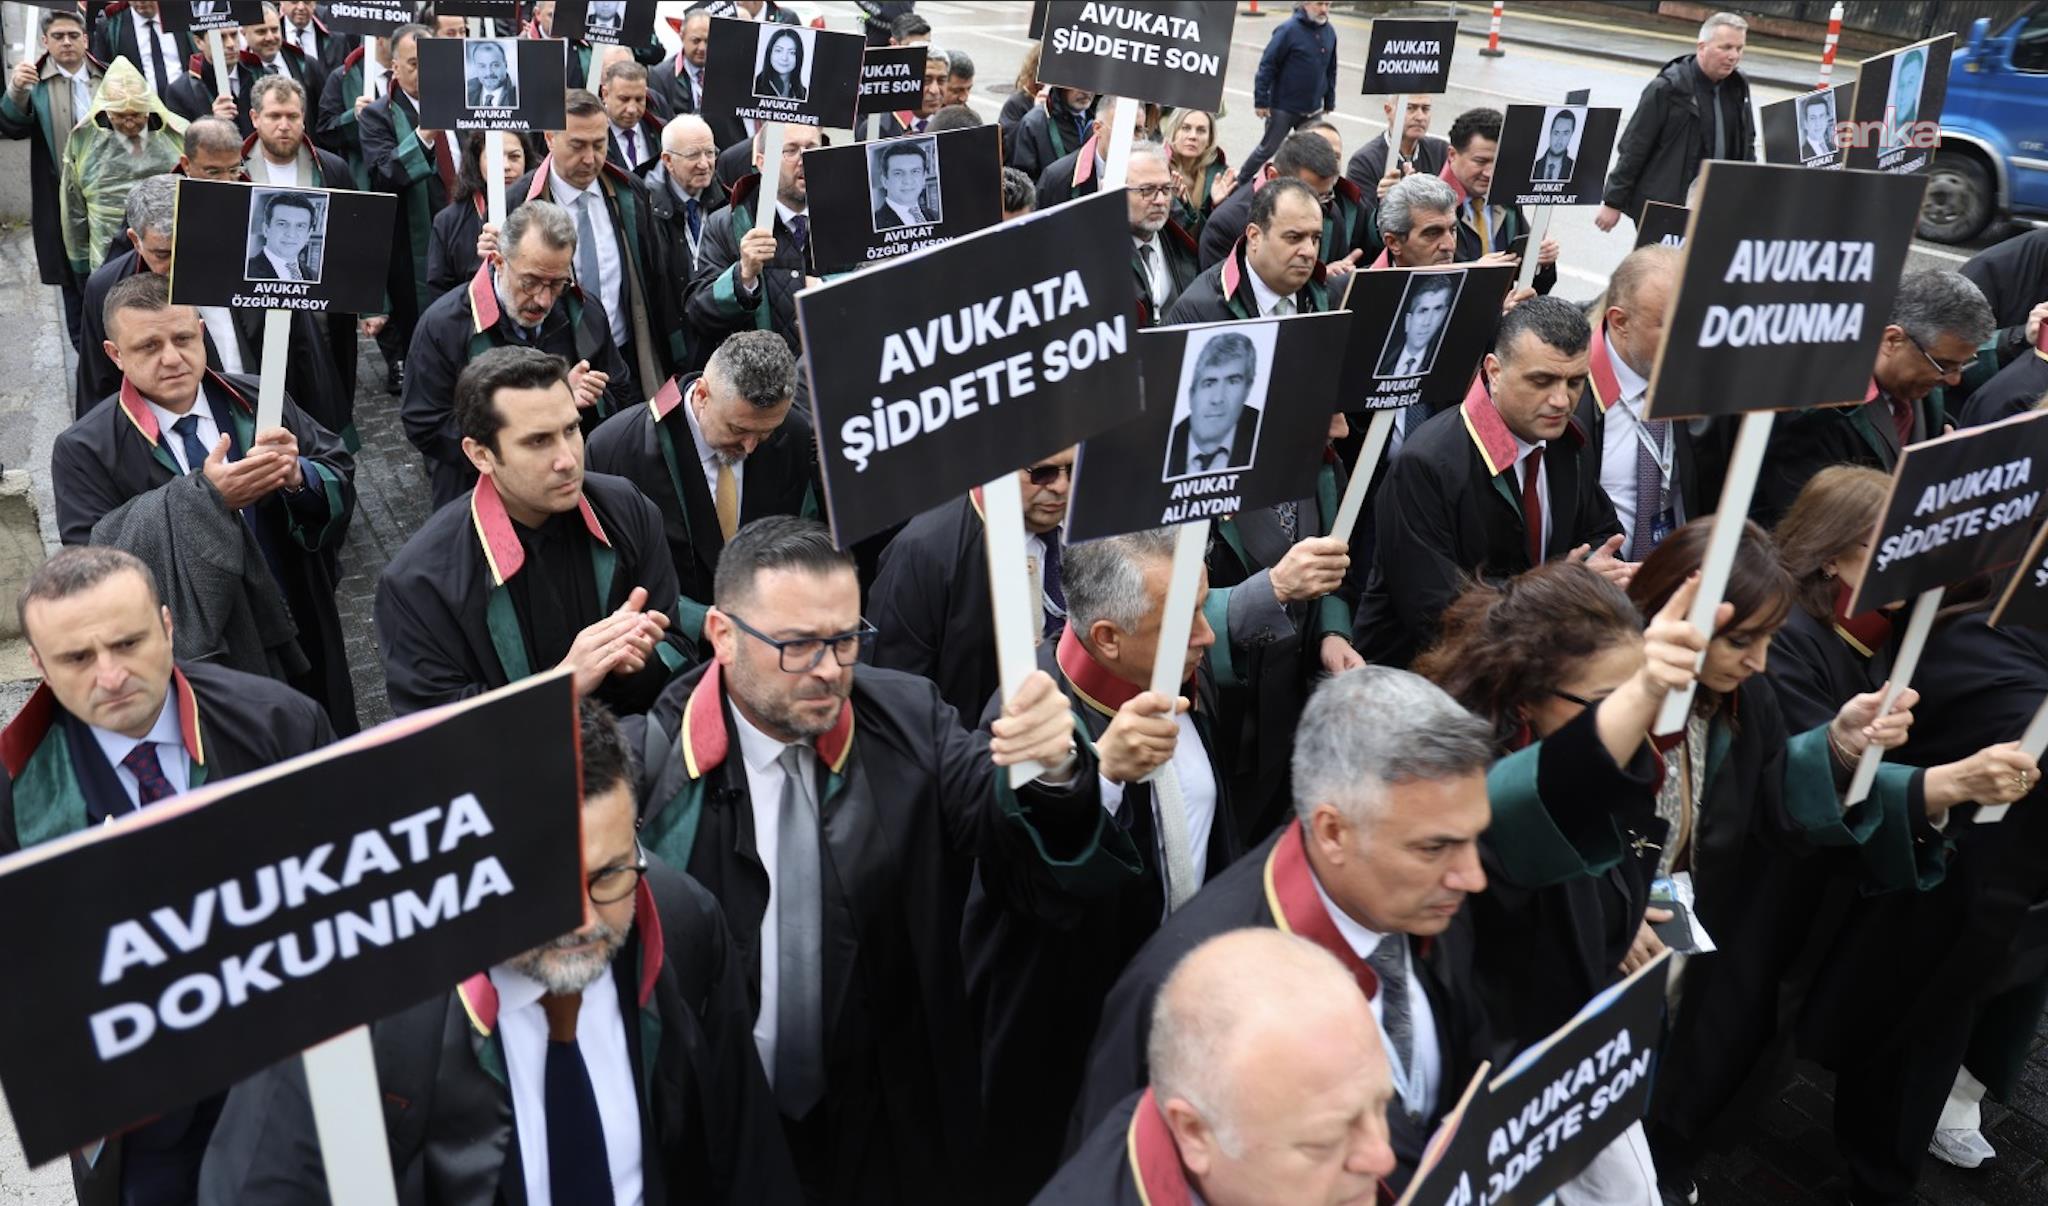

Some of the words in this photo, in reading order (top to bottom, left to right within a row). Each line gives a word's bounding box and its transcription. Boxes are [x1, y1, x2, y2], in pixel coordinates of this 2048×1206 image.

[331, 2, 383, 19] ŞİDDETE
[384, 9, 411, 23] SON
[1079, 2, 1200, 42] AVUKATA
[1052, 25, 1161, 66] ŞİDDETE
[1164, 48, 1220, 77] SON
[1383, 40, 1440, 55] AVUKATA
[1377, 60, 1440, 74] DOKUNMA
[892, 79, 921, 93] SON
[473, 109, 513, 119] AVUKAT
[735, 107, 772, 120] HATİCE
[758, 98, 799, 111] AVUKAT
[456, 118, 489, 129] İSMAİL
[490, 120, 530, 129] AKKAYA
[1532, 183, 1565, 192] AVUKAT
[1551, 194, 1578, 204] POLAT
[884, 226, 934, 242] AVUKAT
[866, 242, 909, 259] ÖZGÜR
[1723, 239, 1875, 284] AVUKATA
[253, 282, 310, 295] AVUKAT
[231, 293, 280, 308] ÖZGÜR
[281, 297, 330, 310] AKSOY
[879, 269, 1090, 384] AVUKATA
[1697, 302, 1864, 348] DOKUNMA
[840, 351, 1037, 474] ŞİDDETE
[1042, 314, 1127, 382] SON
[1376, 377, 1421, 392] AVUKAT
[1365, 393, 1399, 409] TAHİR
[1170, 474, 1240, 500] AVUKAT
[1914, 456, 2032, 517] AVUKATA
[1161, 499, 1189, 524] ALİ
[1187, 496, 1242, 518] AYDIN
[1876, 507, 1987, 573] ŞİDDETE
[1986, 491, 2040, 531] SON
[100, 792, 495, 985] AVUKATA
[89, 855, 515, 1062] DOKUNMA
[1588, 1048, 1652, 1120] SON
[1487, 1028, 1631, 1166] AVUKATA
